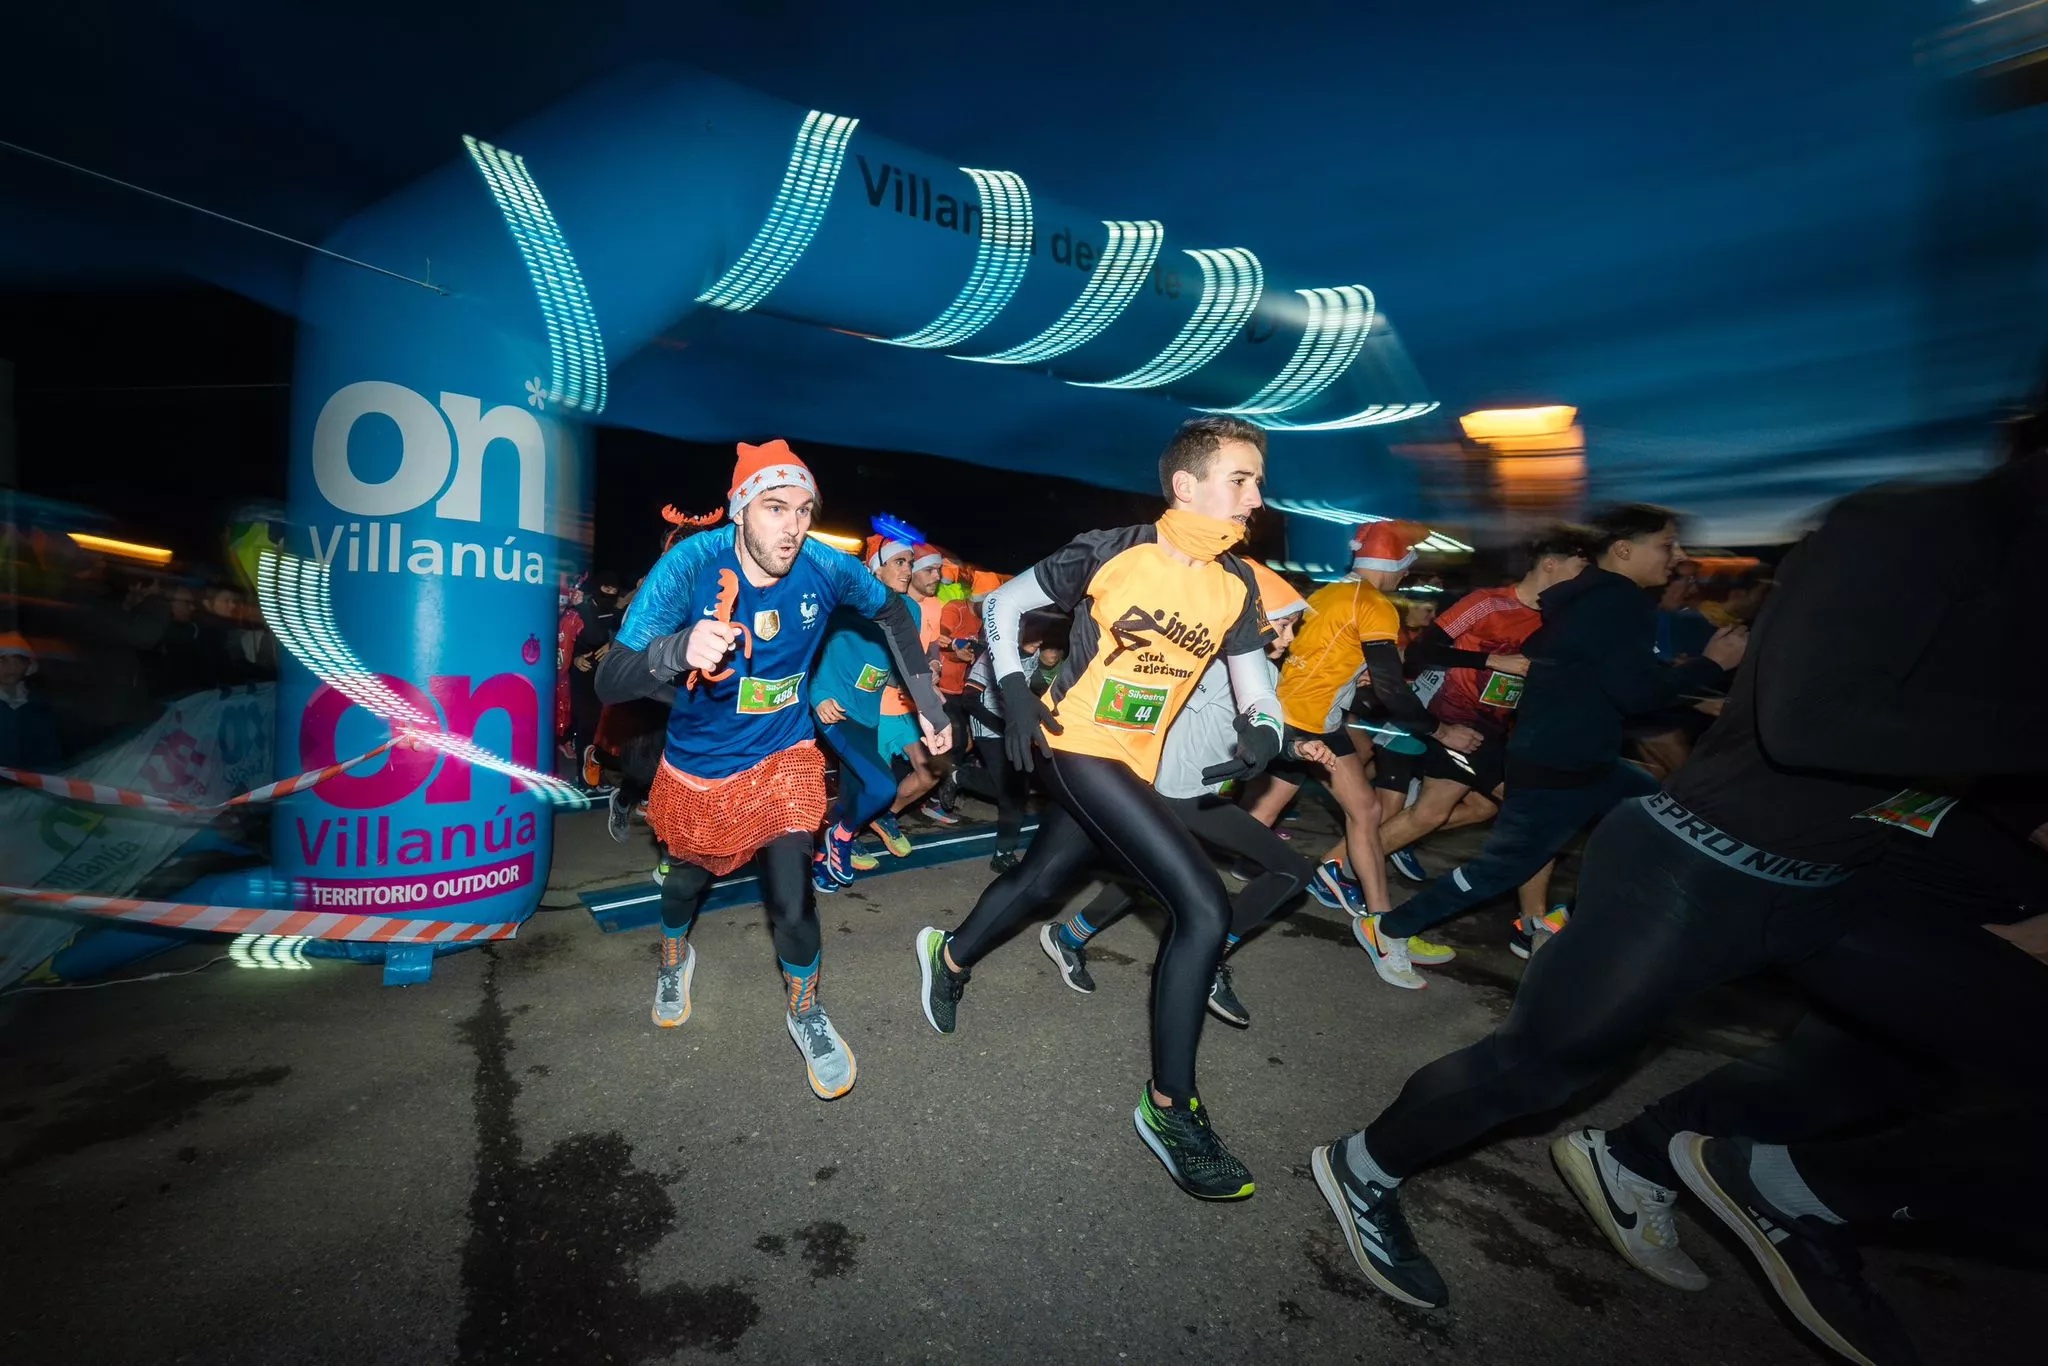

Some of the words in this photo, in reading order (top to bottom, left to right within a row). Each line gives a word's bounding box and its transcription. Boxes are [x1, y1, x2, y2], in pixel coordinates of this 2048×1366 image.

[309, 522, 544, 584] Villanúa
[1137, 651, 1166, 663] club
[1128, 689, 1165, 702] Silvestre
[1134, 705, 1153, 722] 44
[296, 806, 536, 867] Villanúa
[1660, 802, 1744, 857] PRO
[312, 884, 428, 907] TERRITORIO
[433, 865, 520, 899] OUTDOOR
